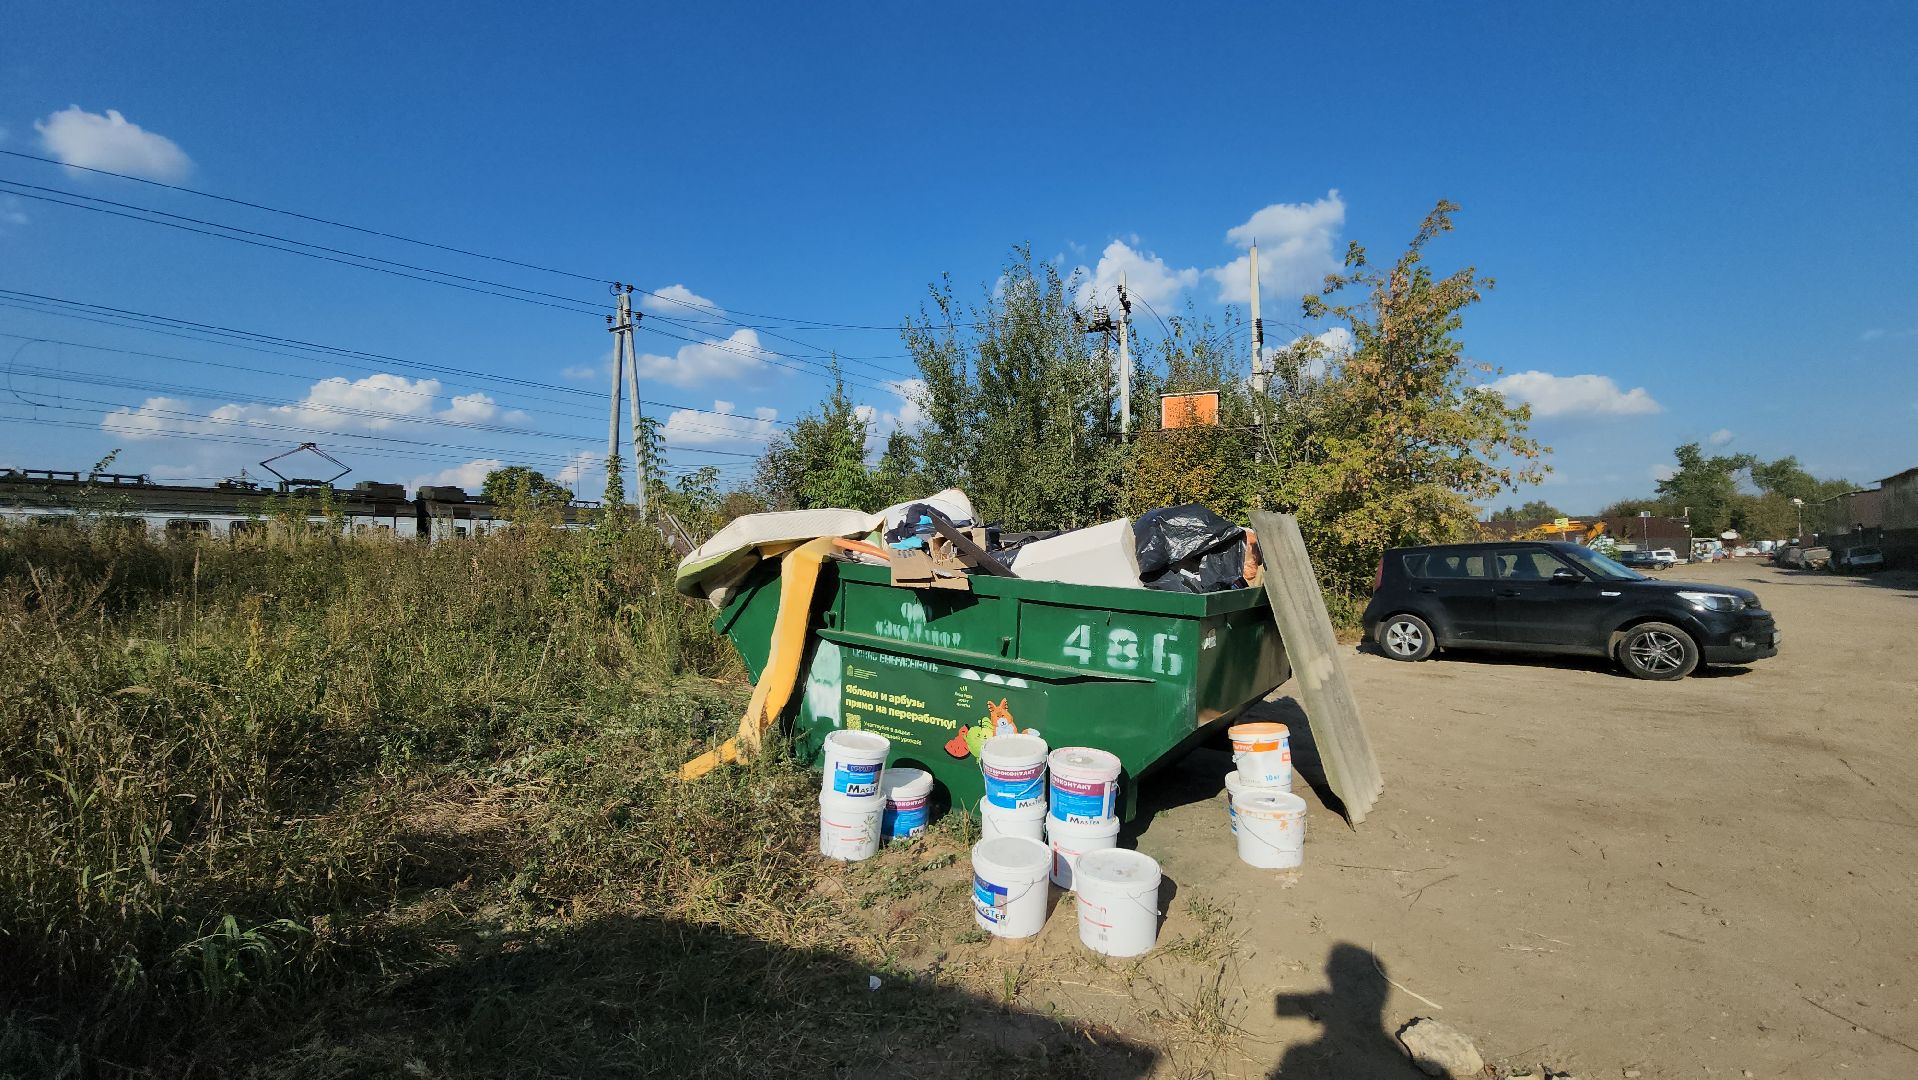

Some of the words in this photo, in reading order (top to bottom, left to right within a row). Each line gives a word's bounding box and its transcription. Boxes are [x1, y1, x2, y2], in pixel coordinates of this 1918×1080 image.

[845, 684, 879, 700] Яблоки
[880, 693, 887, 702] и
[888, 694, 925, 709] арбузы
[845, 698, 874, 711] прямо
[875, 704, 887, 715] на
[888, 707, 957, 730] переработку!
